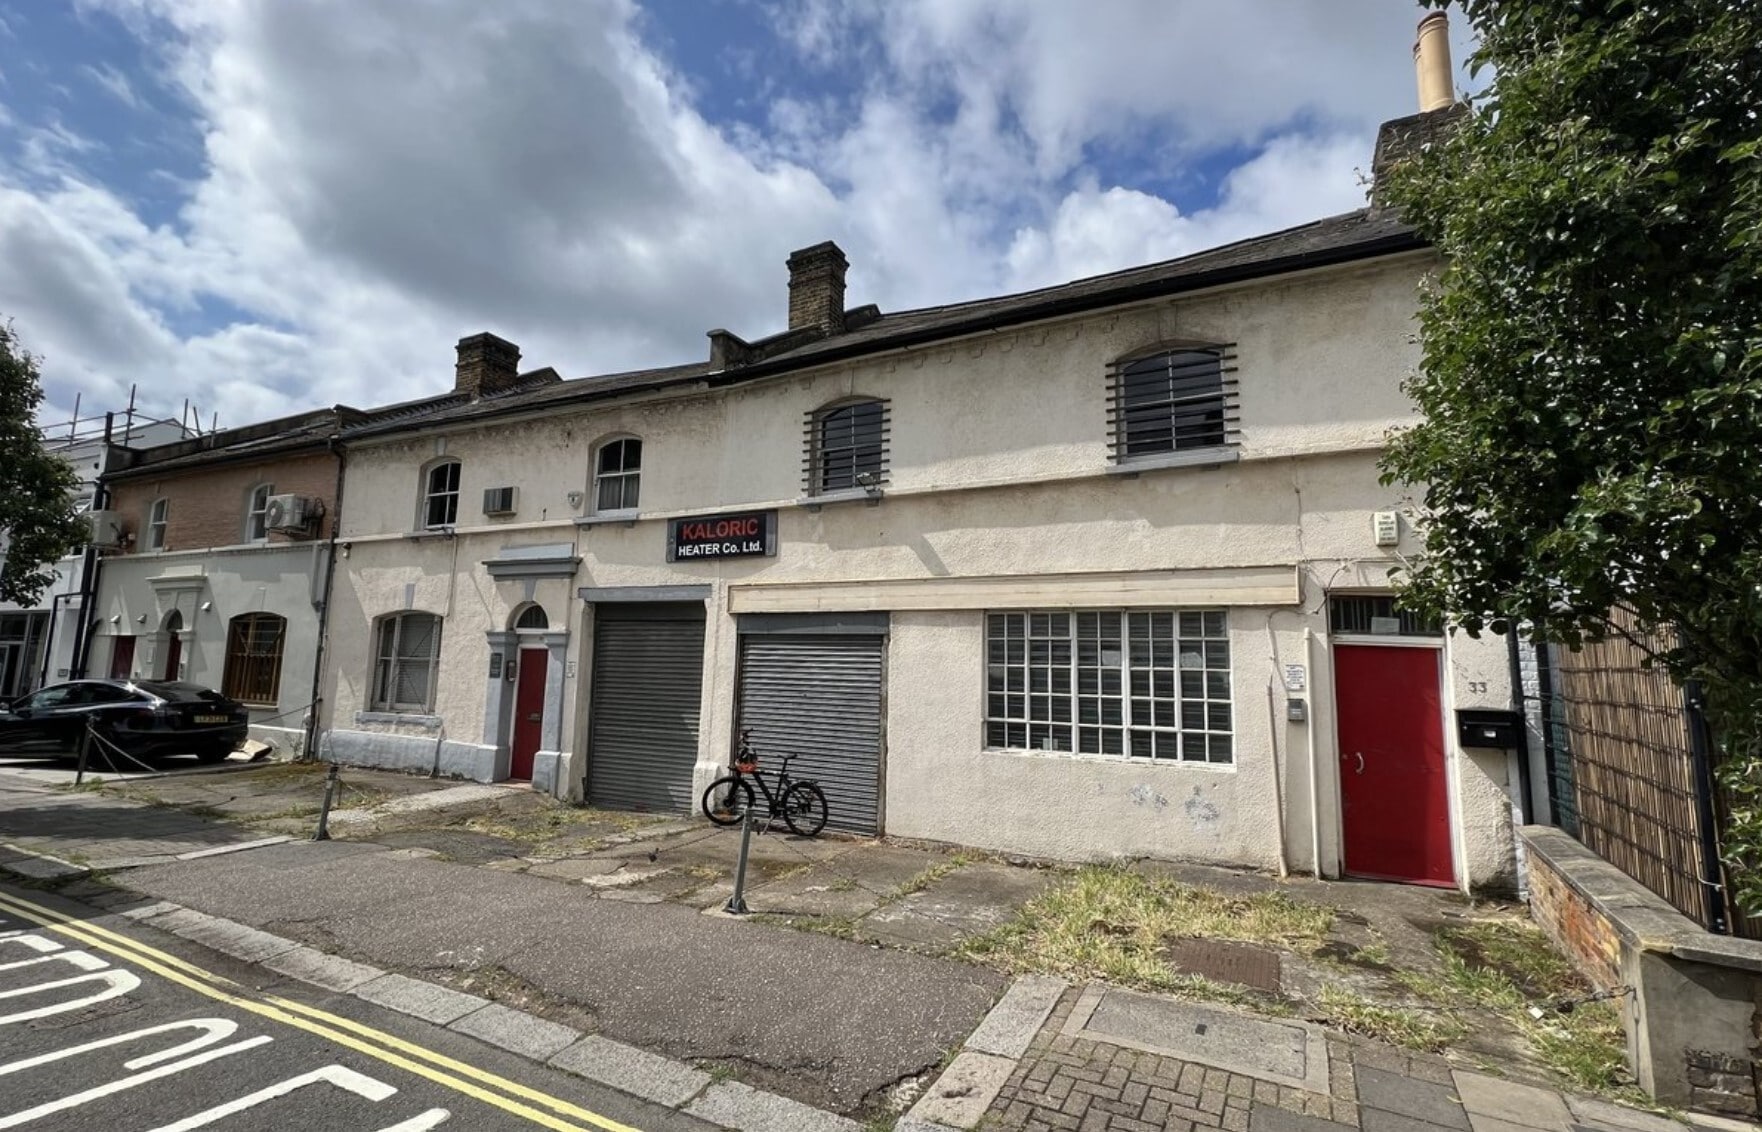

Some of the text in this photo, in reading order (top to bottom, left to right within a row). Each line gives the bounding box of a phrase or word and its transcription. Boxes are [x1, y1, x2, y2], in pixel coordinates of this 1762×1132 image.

[682, 518, 758, 540] KALORIC
[678, 540, 763, 556] HEATER Co. Ltd.
[1468, 681, 1487, 694] 33
